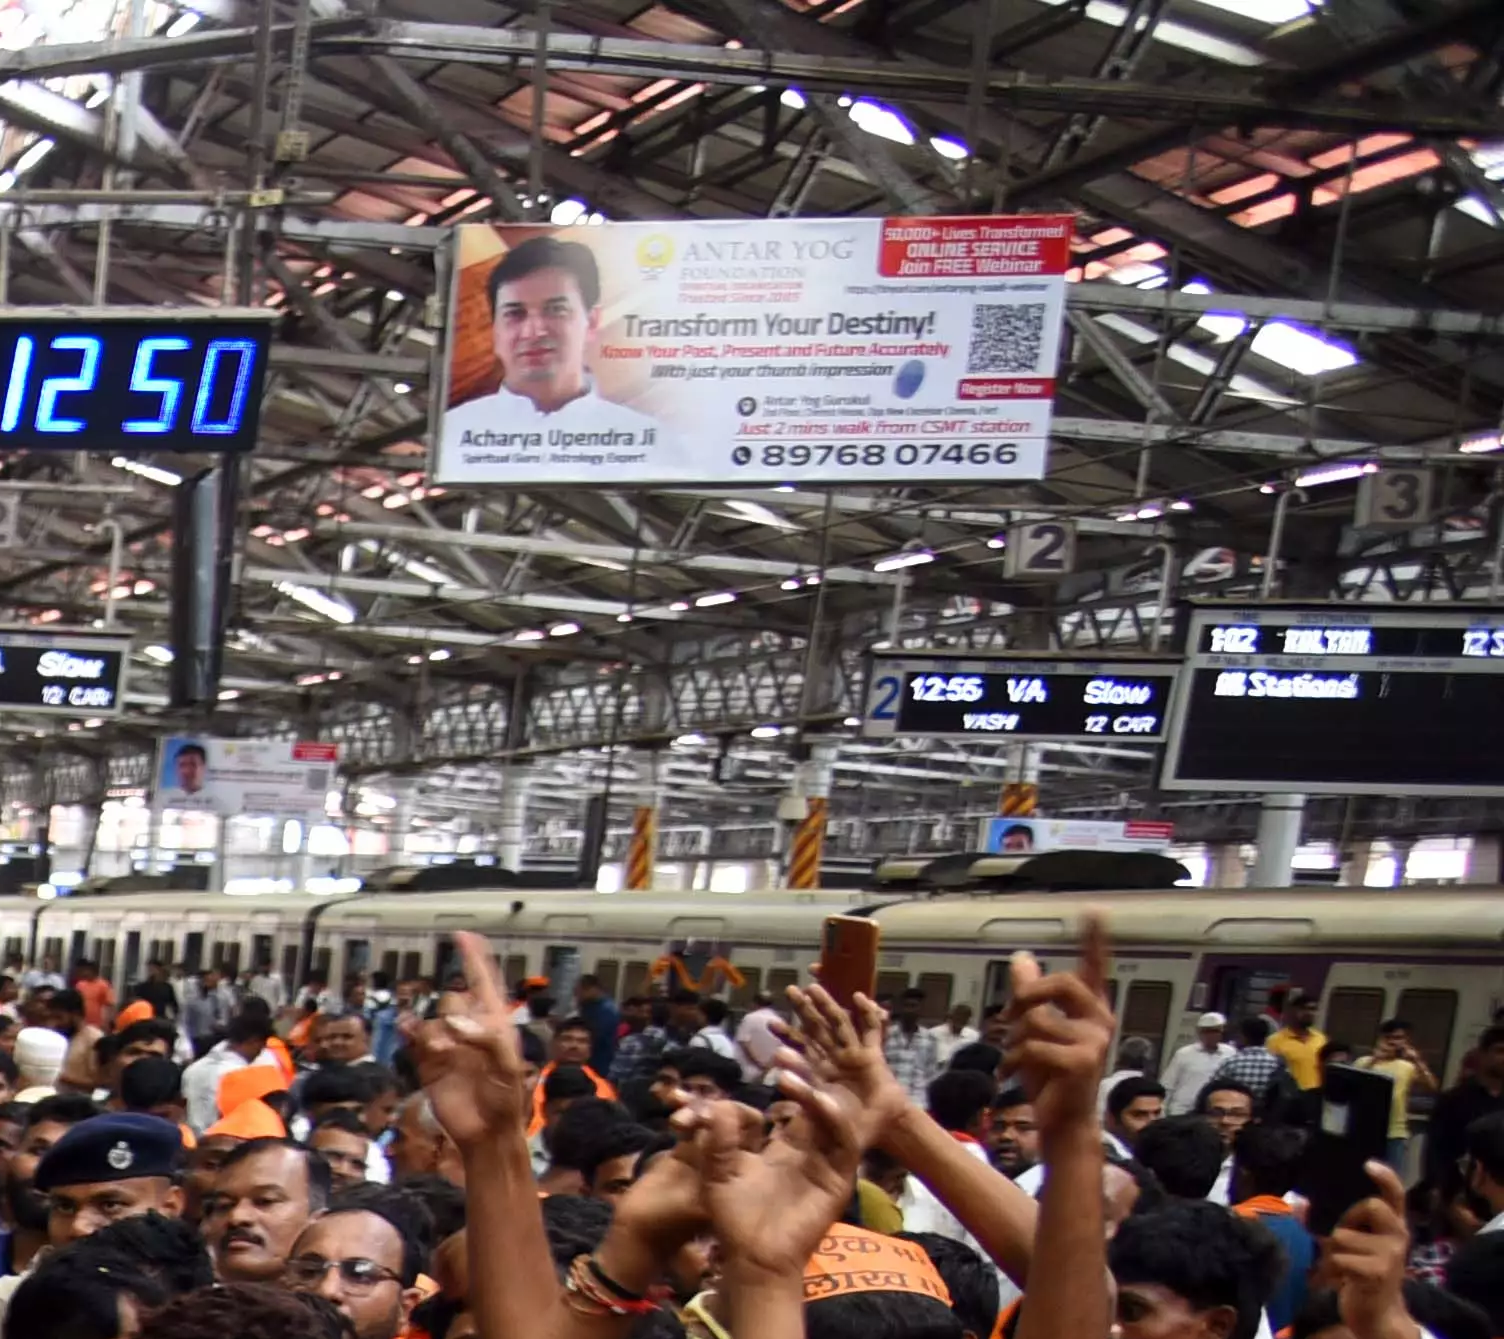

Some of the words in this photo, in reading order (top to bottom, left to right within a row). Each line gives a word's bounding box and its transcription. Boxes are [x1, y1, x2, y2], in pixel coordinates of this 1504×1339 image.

[943, 225, 975, 239] Lives
[980, 223, 1064, 239] Transformed
[682, 240, 782, 261] ANTAR
[791, 237, 855, 260] YOG
[907, 242, 967, 258] ONLINE
[972, 241, 1038, 256] SERVICE
[898, 259, 930, 275] Join
[934, 259, 973, 273] FREE
[976, 258, 1044, 273] Webinar
[624, 313, 758, 338] Transform
[764, 312, 823, 336] Your
[827, 310, 936, 340] Destiny!
[815, 343, 866, 357] Future
[868, 341, 951, 358] Accurately
[808, 361, 894, 378] impression
[736, 421, 772, 435] Just
[774, 422, 786, 434] 2
[788, 421, 828, 434] mins
[875, 420, 916, 433] from
[920, 420, 967, 433] CSMT
[970, 418, 1031, 433] station
[460, 429, 542, 450] Acharya
[548, 428, 634, 450] Upendra
[639, 428, 656, 446] Ji
[761, 444, 886, 467] 89768
[895, 443, 1018, 466] 07466
[1383, 474, 1420, 519] 3
[1026, 524, 1065, 570] 2
[871, 676, 899, 720] 2
[1007, 678, 1047, 703] VA
[1083, 680, 1152, 705] Slow
